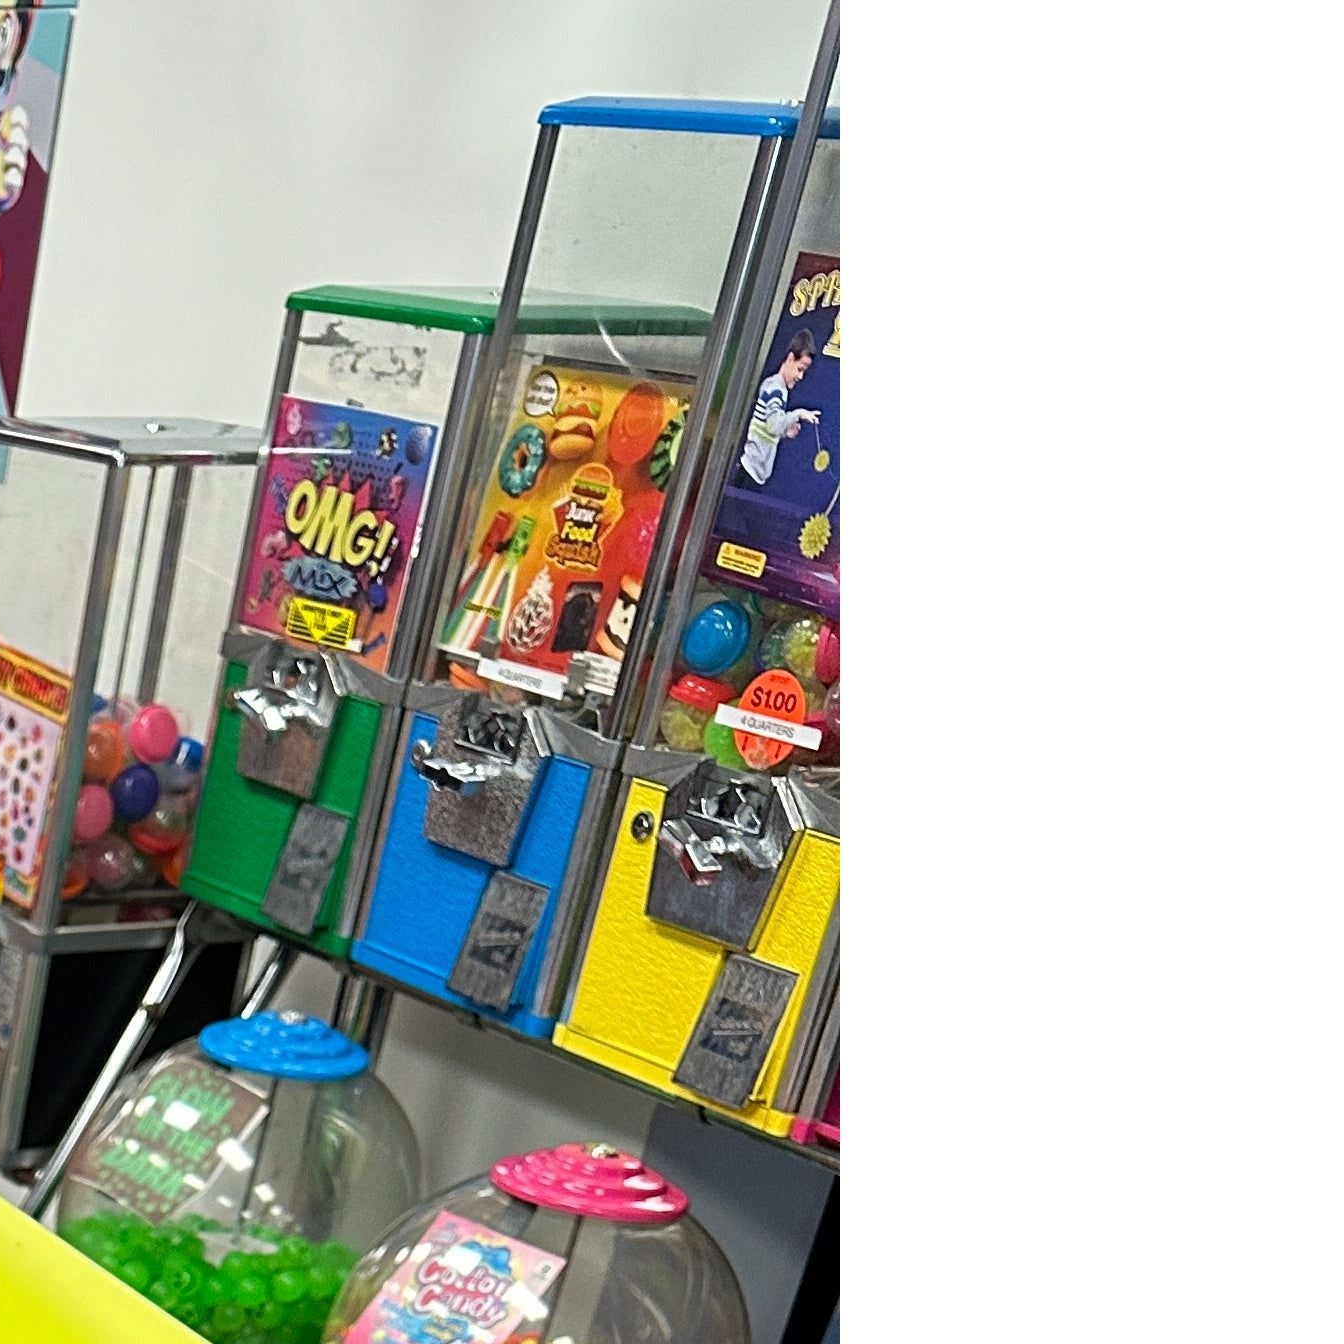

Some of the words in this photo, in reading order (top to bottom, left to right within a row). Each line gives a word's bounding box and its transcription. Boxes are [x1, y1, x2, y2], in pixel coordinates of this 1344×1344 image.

[285, 479, 396, 578] OMG!
[740, 715, 747, 725] 4
[747, 716, 796, 738] QUARTERS
[414, 1284, 509, 1329] Candy
